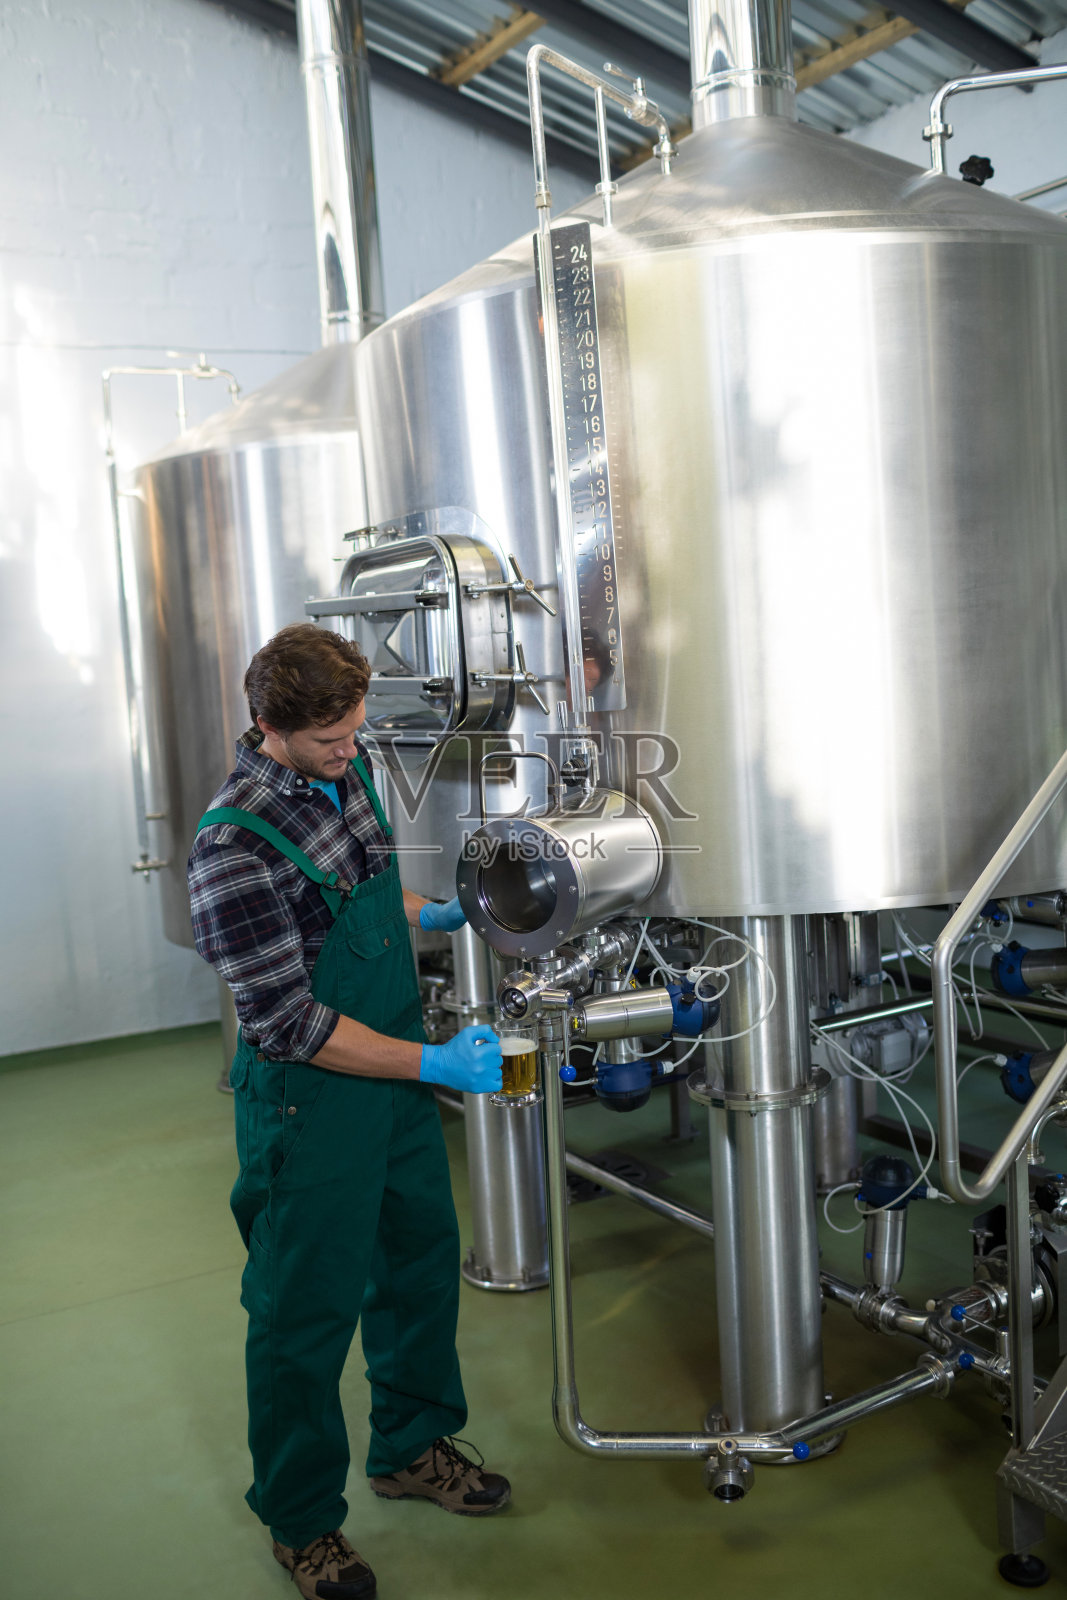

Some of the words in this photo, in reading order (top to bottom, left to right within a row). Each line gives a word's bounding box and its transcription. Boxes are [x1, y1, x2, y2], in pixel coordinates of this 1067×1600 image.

[570, 244, 588, 263] 24
[572, 266, 589, 284] 23
[574, 288, 591, 306] 22
[575, 309, 590, 328] 21
[576, 330, 594, 349] 20
[579, 352, 594, 370] 19
[580, 373, 596, 391] 18
[582, 394, 597, 412] 17
[583, 416, 600, 434] 16
[585, 437, 602, 457] 15
[588, 459, 604, 476] 14
[588, 480, 606, 497] 13
[590, 502, 608, 520] 12
[592, 522, 606, 540] 11
[593, 544, 610, 562] 10
[604, 565, 612, 581] 9
[605, 586, 614, 602] 8
[606, 607, 614, 624] 7
[610, 650, 618, 666] 5
